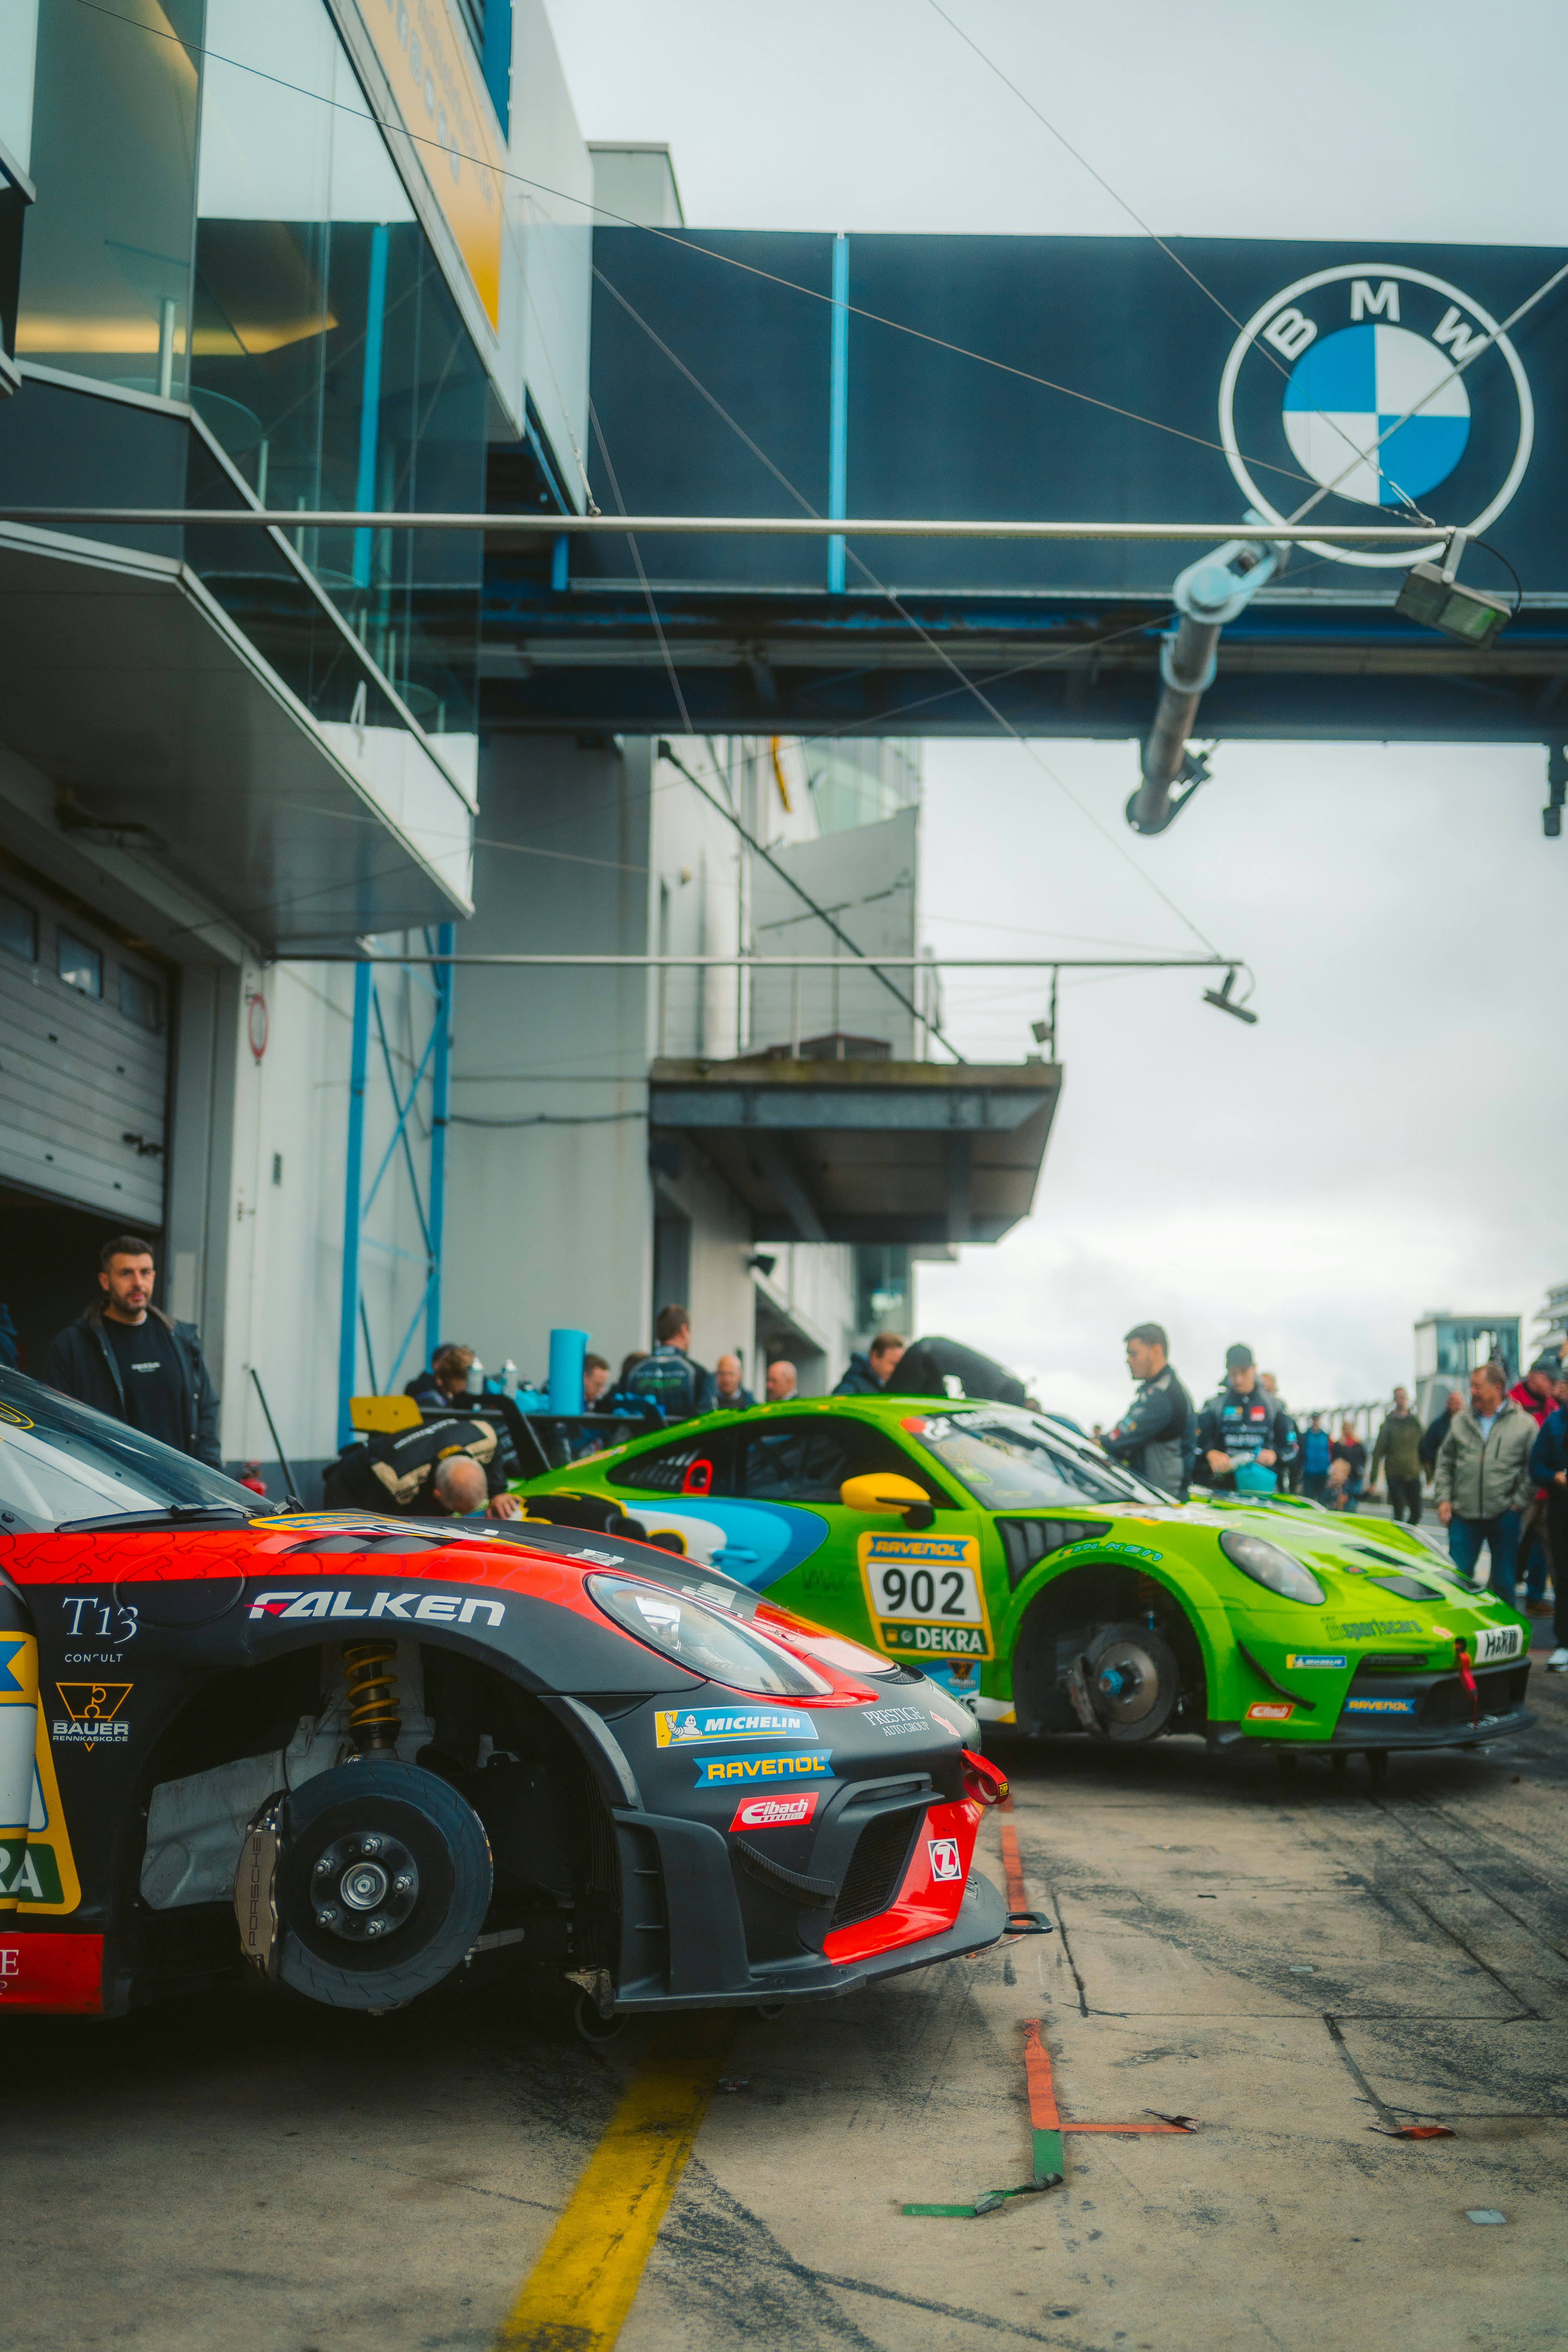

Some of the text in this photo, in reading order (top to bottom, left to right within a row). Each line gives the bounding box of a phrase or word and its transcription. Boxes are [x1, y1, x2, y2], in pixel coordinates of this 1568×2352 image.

[1262, 280, 1490, 362] BMW
[875, 1540, 959, 1557] RAVENOL
[883, 1568, 965, 1615] 902
[62, 1597, 139, 1644] T13
[245, 1591, 506, 1627] FALKEN
[916, 1627, 983, 1653] DEKRA
[861, 1706, 925, 1726] PRESTIGE
[1348, 1700, 1409, 1711] RAVENOL
[53, 1722, 129, 1735] BAUER
[705, 1716, 800, 1731] MICHELIN
[708, 1757, 825, 1780] RAVENOL
[741, 1799, 809, 1824] Eibach
[248, 1836, 262, 1947] PORSCHE
